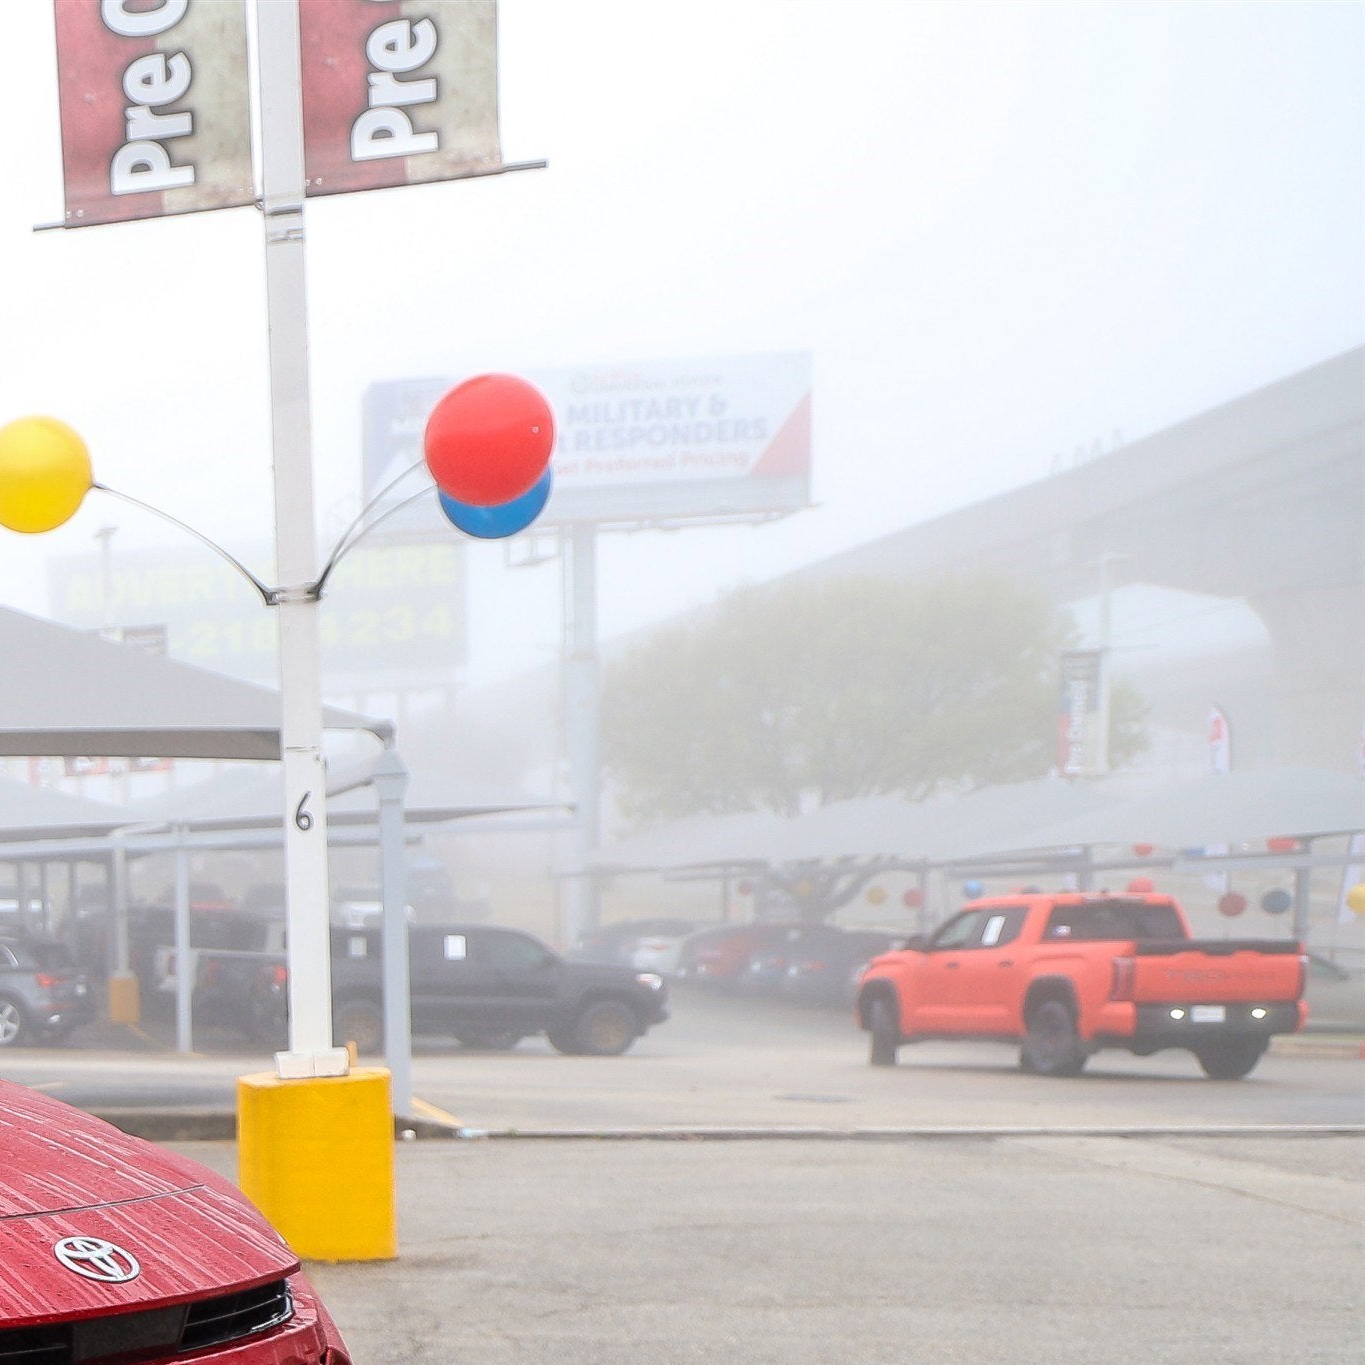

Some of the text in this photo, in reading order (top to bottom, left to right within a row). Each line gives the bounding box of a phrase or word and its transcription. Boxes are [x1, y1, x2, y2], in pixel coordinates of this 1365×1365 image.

[350, 16, 439, 162] Pre
[110, 51, 196, 196] Pre
[567, 396, 701, 424] MILITARY
[574, 416, 769, 450] RESPONDERS
[333, 546, 454, 588] HERE
[295, 790, 314, 831] 6
